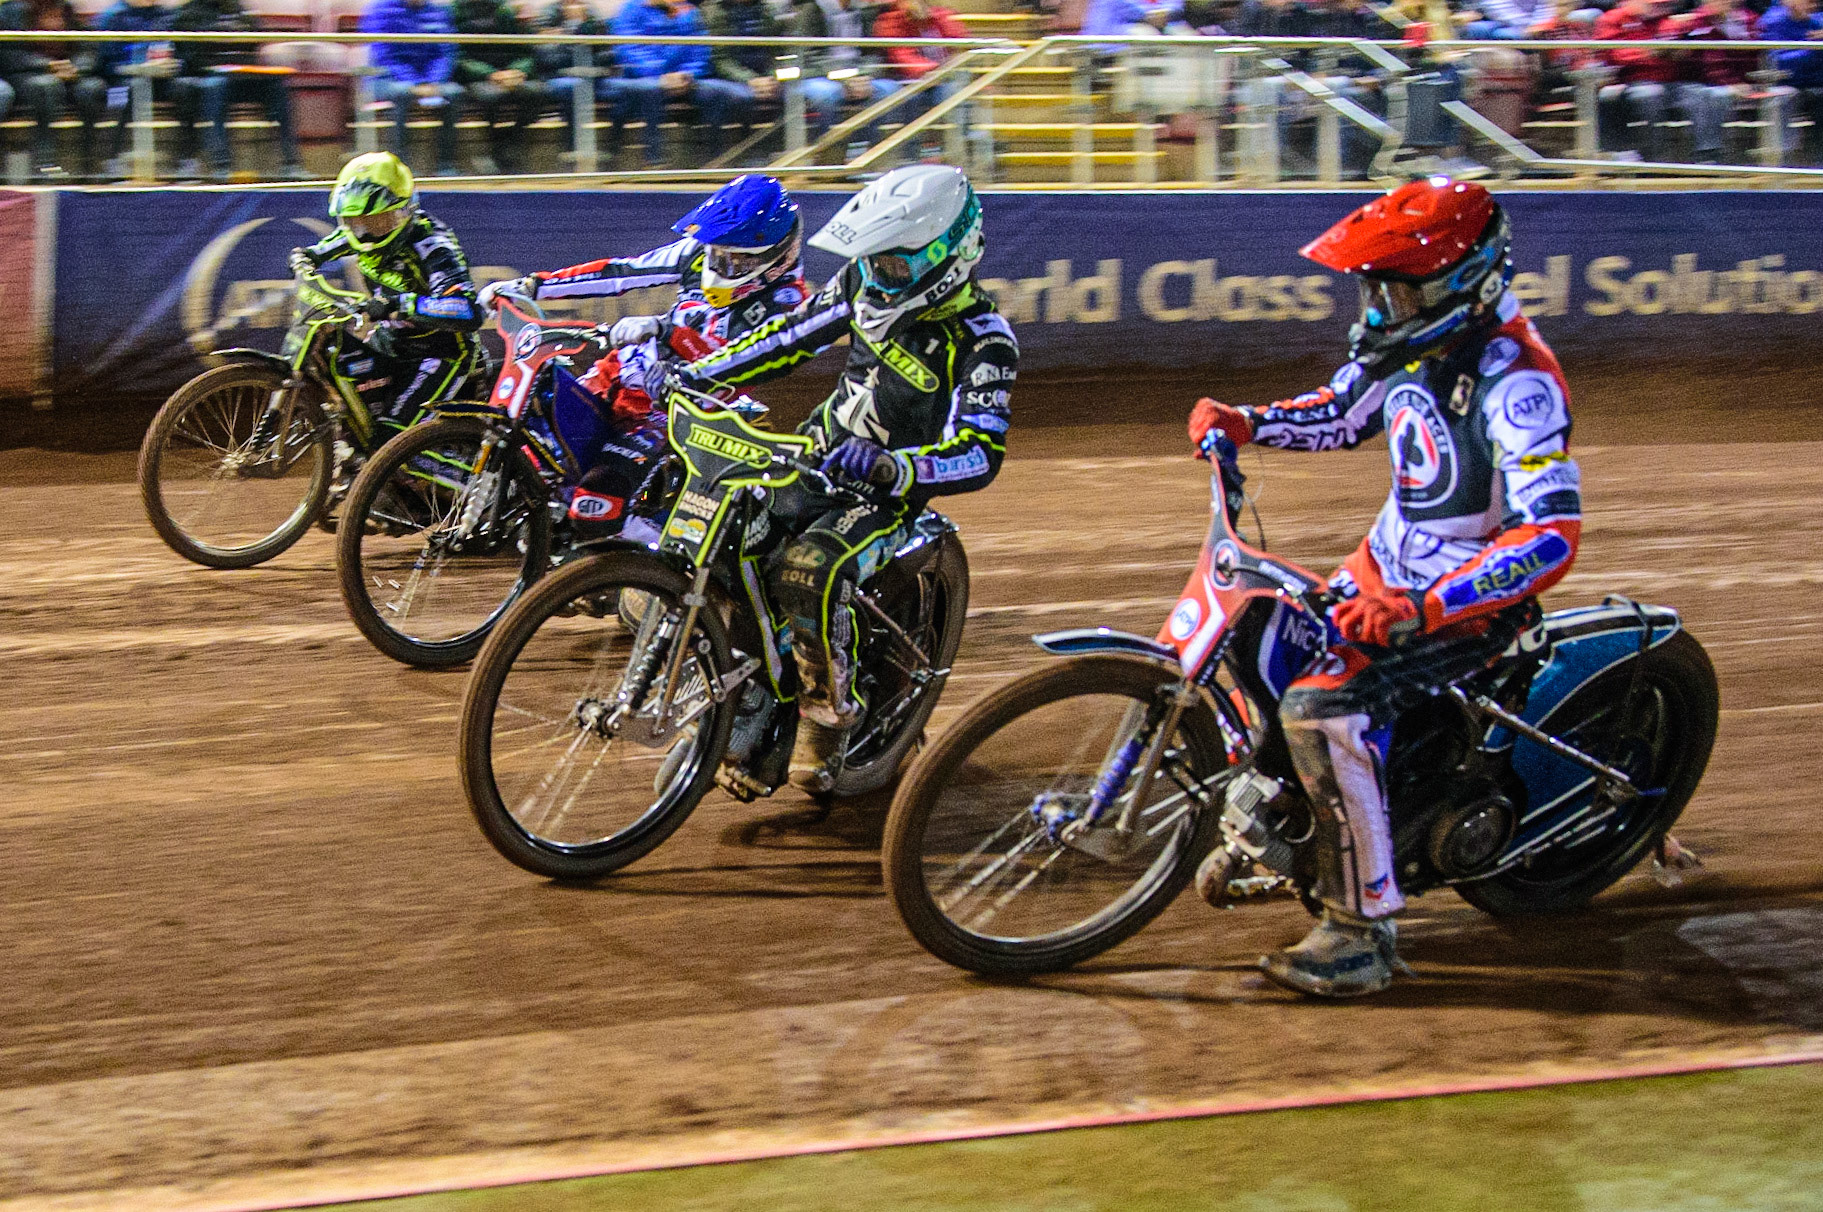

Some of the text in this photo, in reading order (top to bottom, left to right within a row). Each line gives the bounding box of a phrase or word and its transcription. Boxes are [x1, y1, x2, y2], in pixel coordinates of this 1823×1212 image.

[1138, 258, 1336, 322] Class
[885, 348, 931, 386] MIX
[692, 430, 723, 449] TRU
